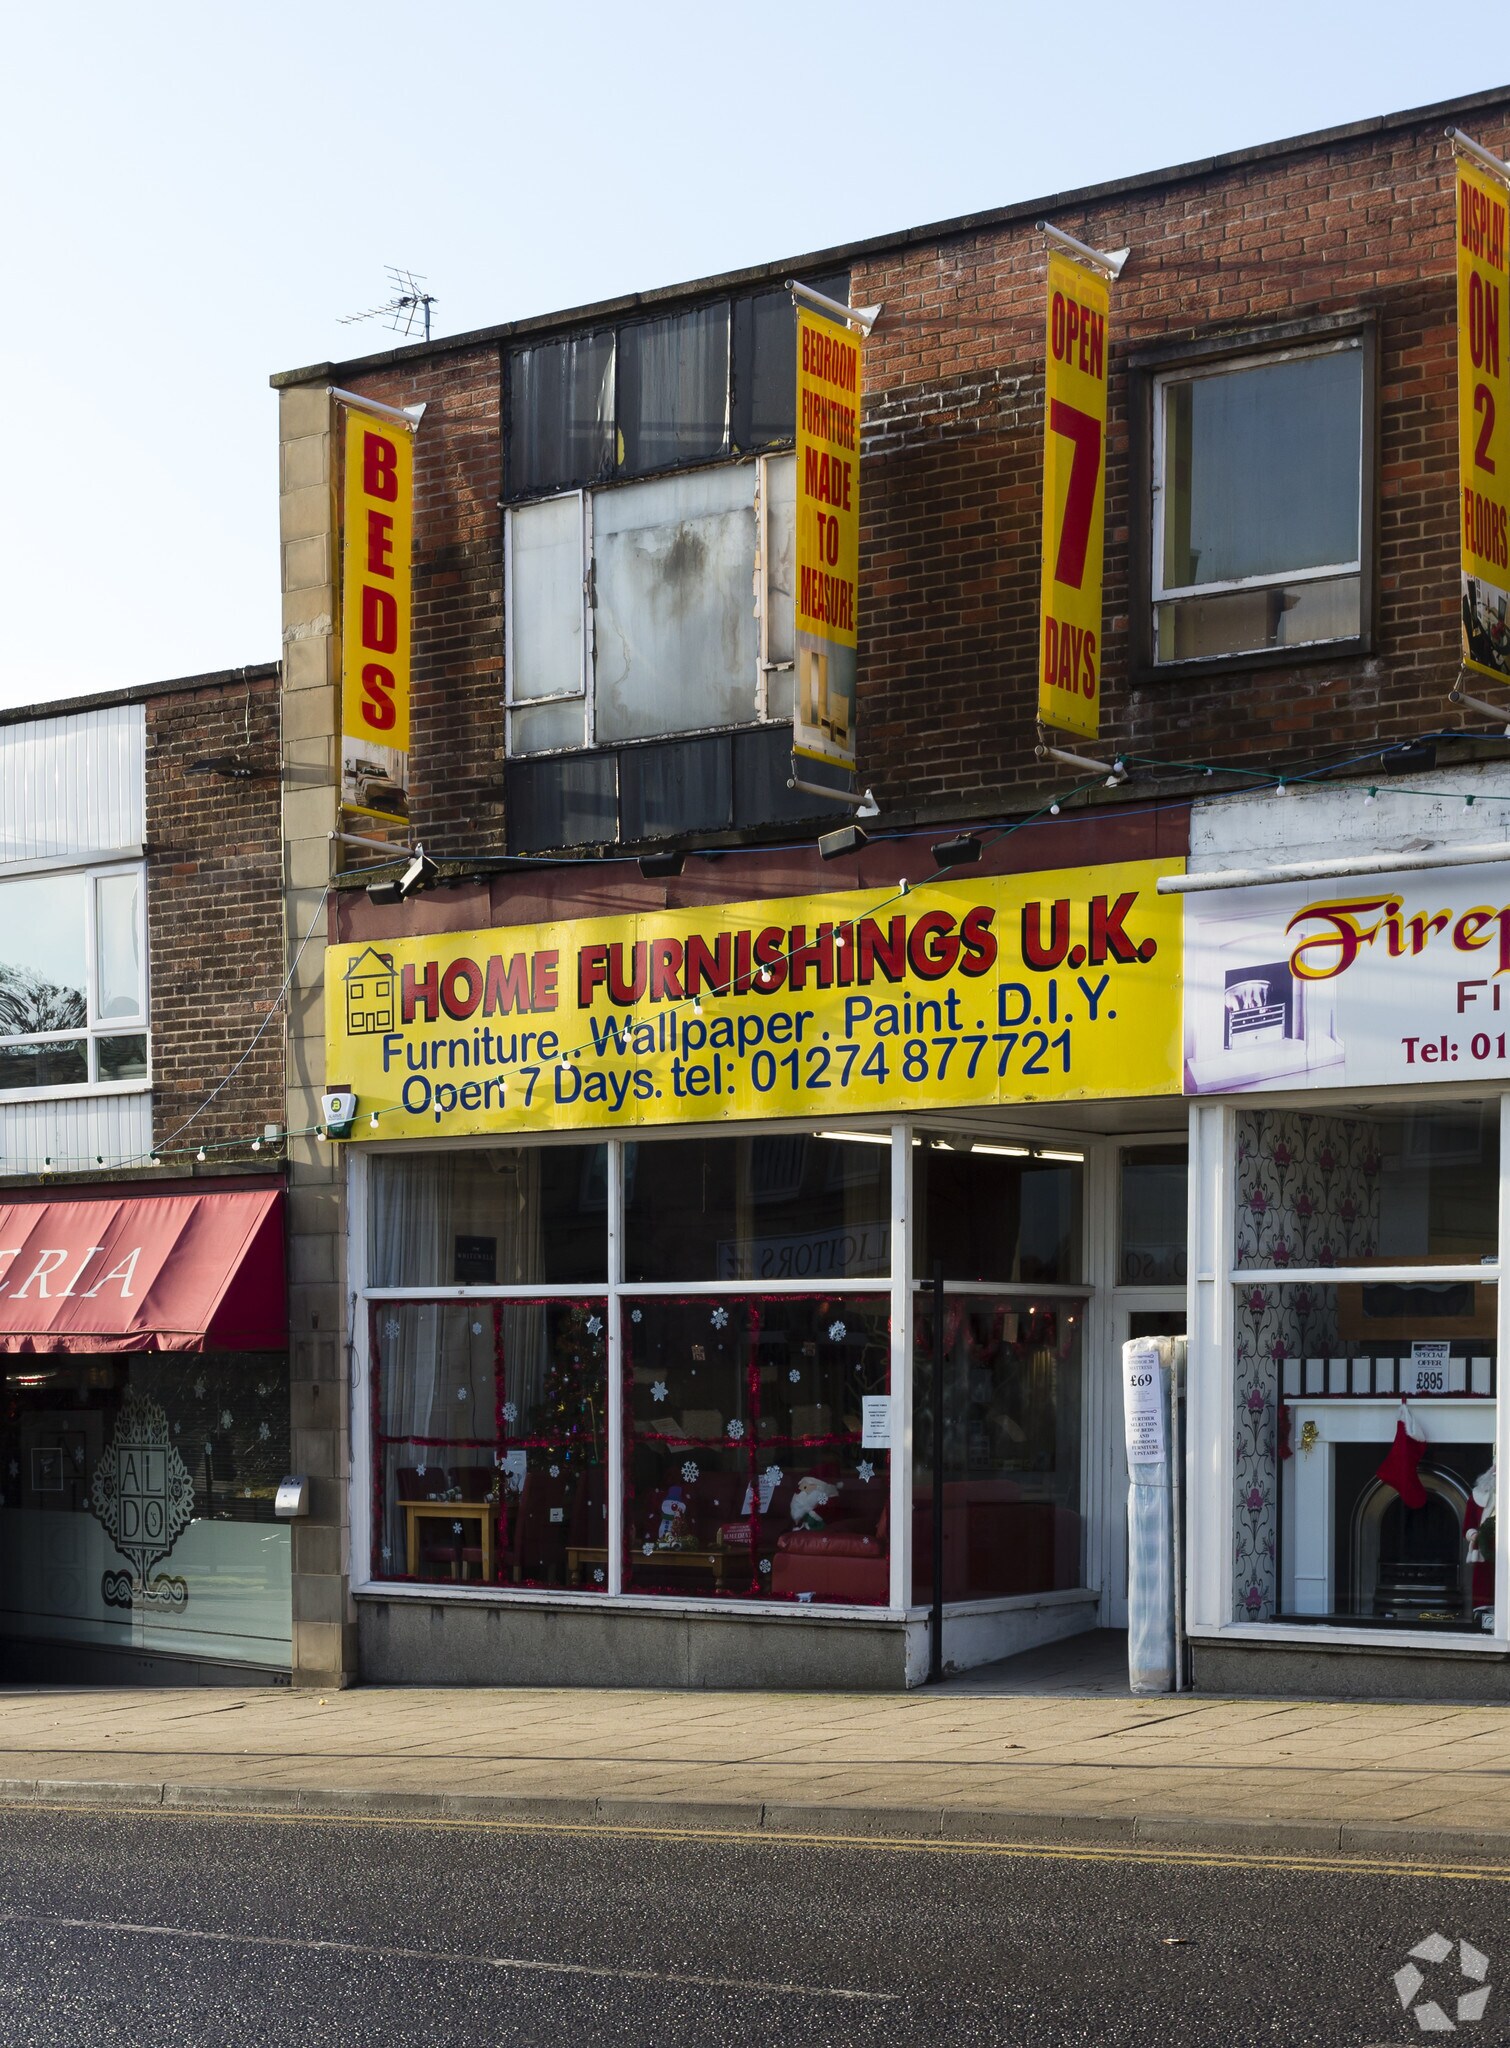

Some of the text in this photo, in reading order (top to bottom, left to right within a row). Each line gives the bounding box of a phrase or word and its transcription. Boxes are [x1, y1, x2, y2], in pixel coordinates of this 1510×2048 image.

[1460, 178, 1506, 273] DISPLAY
[802, 325, 857, 394] BEDROOM
[1051, 290, 1104, 380] OPEN
[1469, 270, 1500, 380] ON
[802, 387, 856, 452] FURNITURE
[1473, 382, 1496, 476] 2
[804, 444, 852, 513] MADE
[1050, 397, 1101, 590] 7
[817, 511, 839, 567] TO
[1464, 486, 1508, 570] FLOORS
[362, 430, 398, 731] BEDS
[800, 564, 854, 633] MEASURE
[1044, 615, 1096, 700] DAYS
[401, 891, 1157, 1025] HOME FURNISHINGS U.K.
[1457, 979, 1500, 1014] FI
[589, 1010, 814, 1062] Wallpaper
[844, 988, 963, 1039] Paint
[997, 973, 1117, 1028] D.I.Y.
[1401, 1032, 1507, 1064] Tel: 01
[401, 1028, 1071, 1124] Open 7 Days. tel: 01274 877721
[1130, 1374, 1153, 1387] £69
[1416, 1372, 1443, 1390] £895
